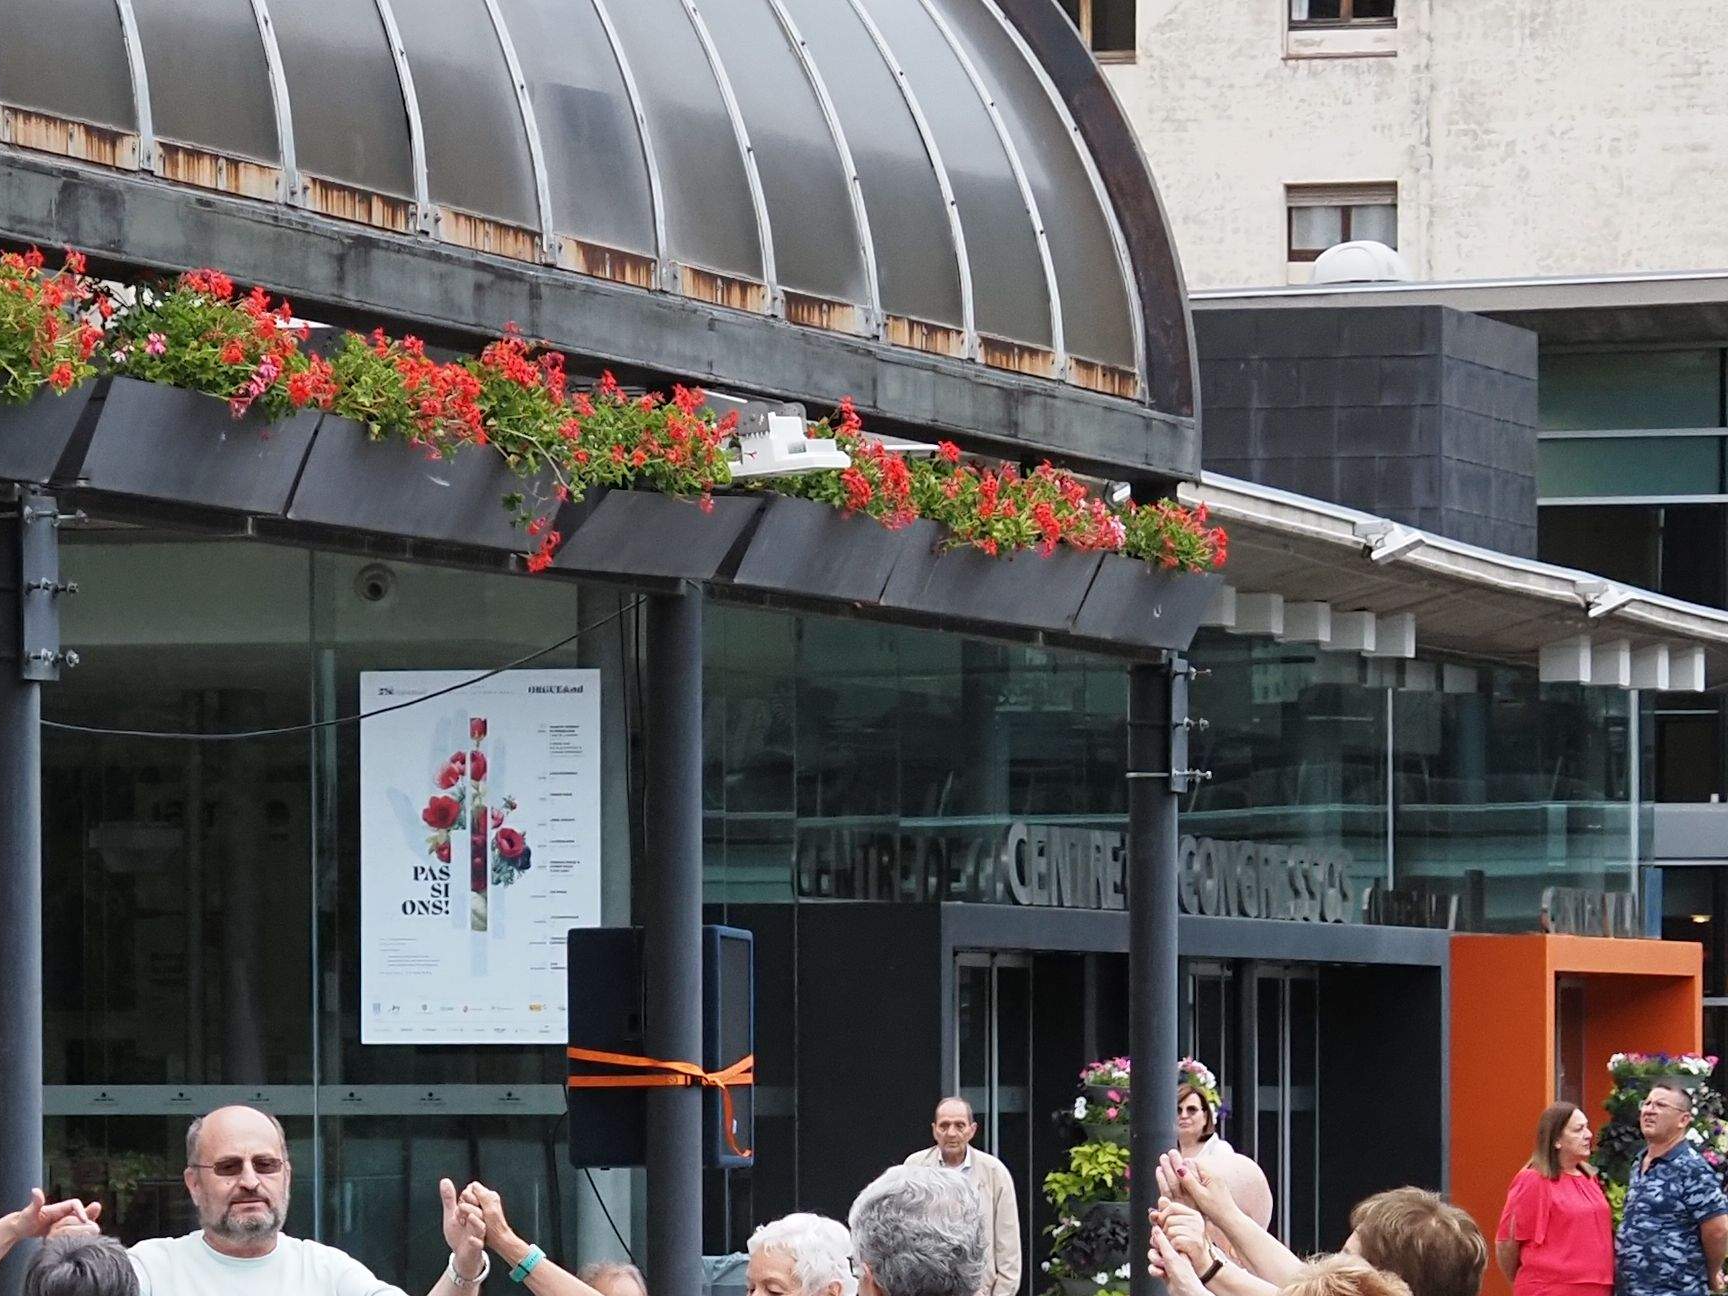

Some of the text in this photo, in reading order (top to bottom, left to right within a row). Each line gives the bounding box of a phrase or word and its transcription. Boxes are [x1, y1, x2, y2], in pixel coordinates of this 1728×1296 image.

[413, 865, 451, 881] PAS
[1008, 821, 1125, 911] CENTRE
[430, 883, 449, 898] SI
[401, 900, 450, 915] ONS!
